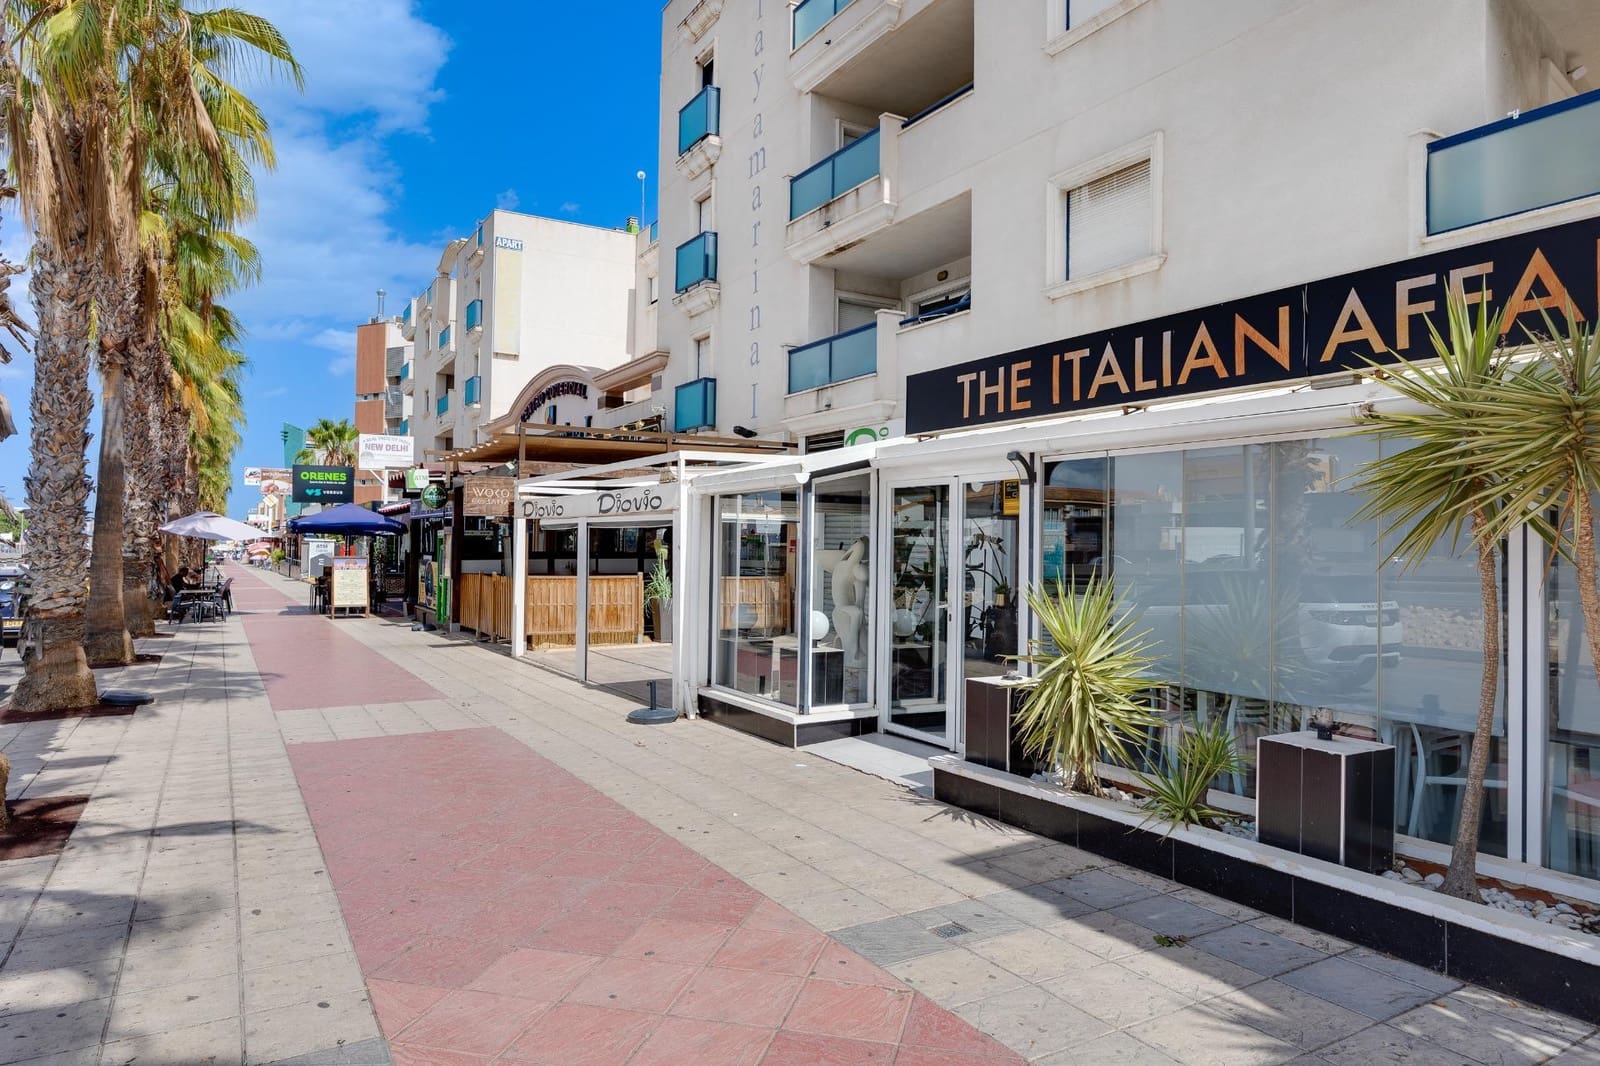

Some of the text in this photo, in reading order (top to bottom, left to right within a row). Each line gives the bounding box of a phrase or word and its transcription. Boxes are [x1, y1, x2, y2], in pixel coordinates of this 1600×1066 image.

[496, 237, 523, 250] APART
[956, 238, 1600, 419] THE ITALIAN AFFA
[365, 442, 409, 452] NEW DELHI
[300, 471, 347, 481] ORENES
[521, 500, 564, 518] Diovio
[596, 489, 663, 515] Diovio
